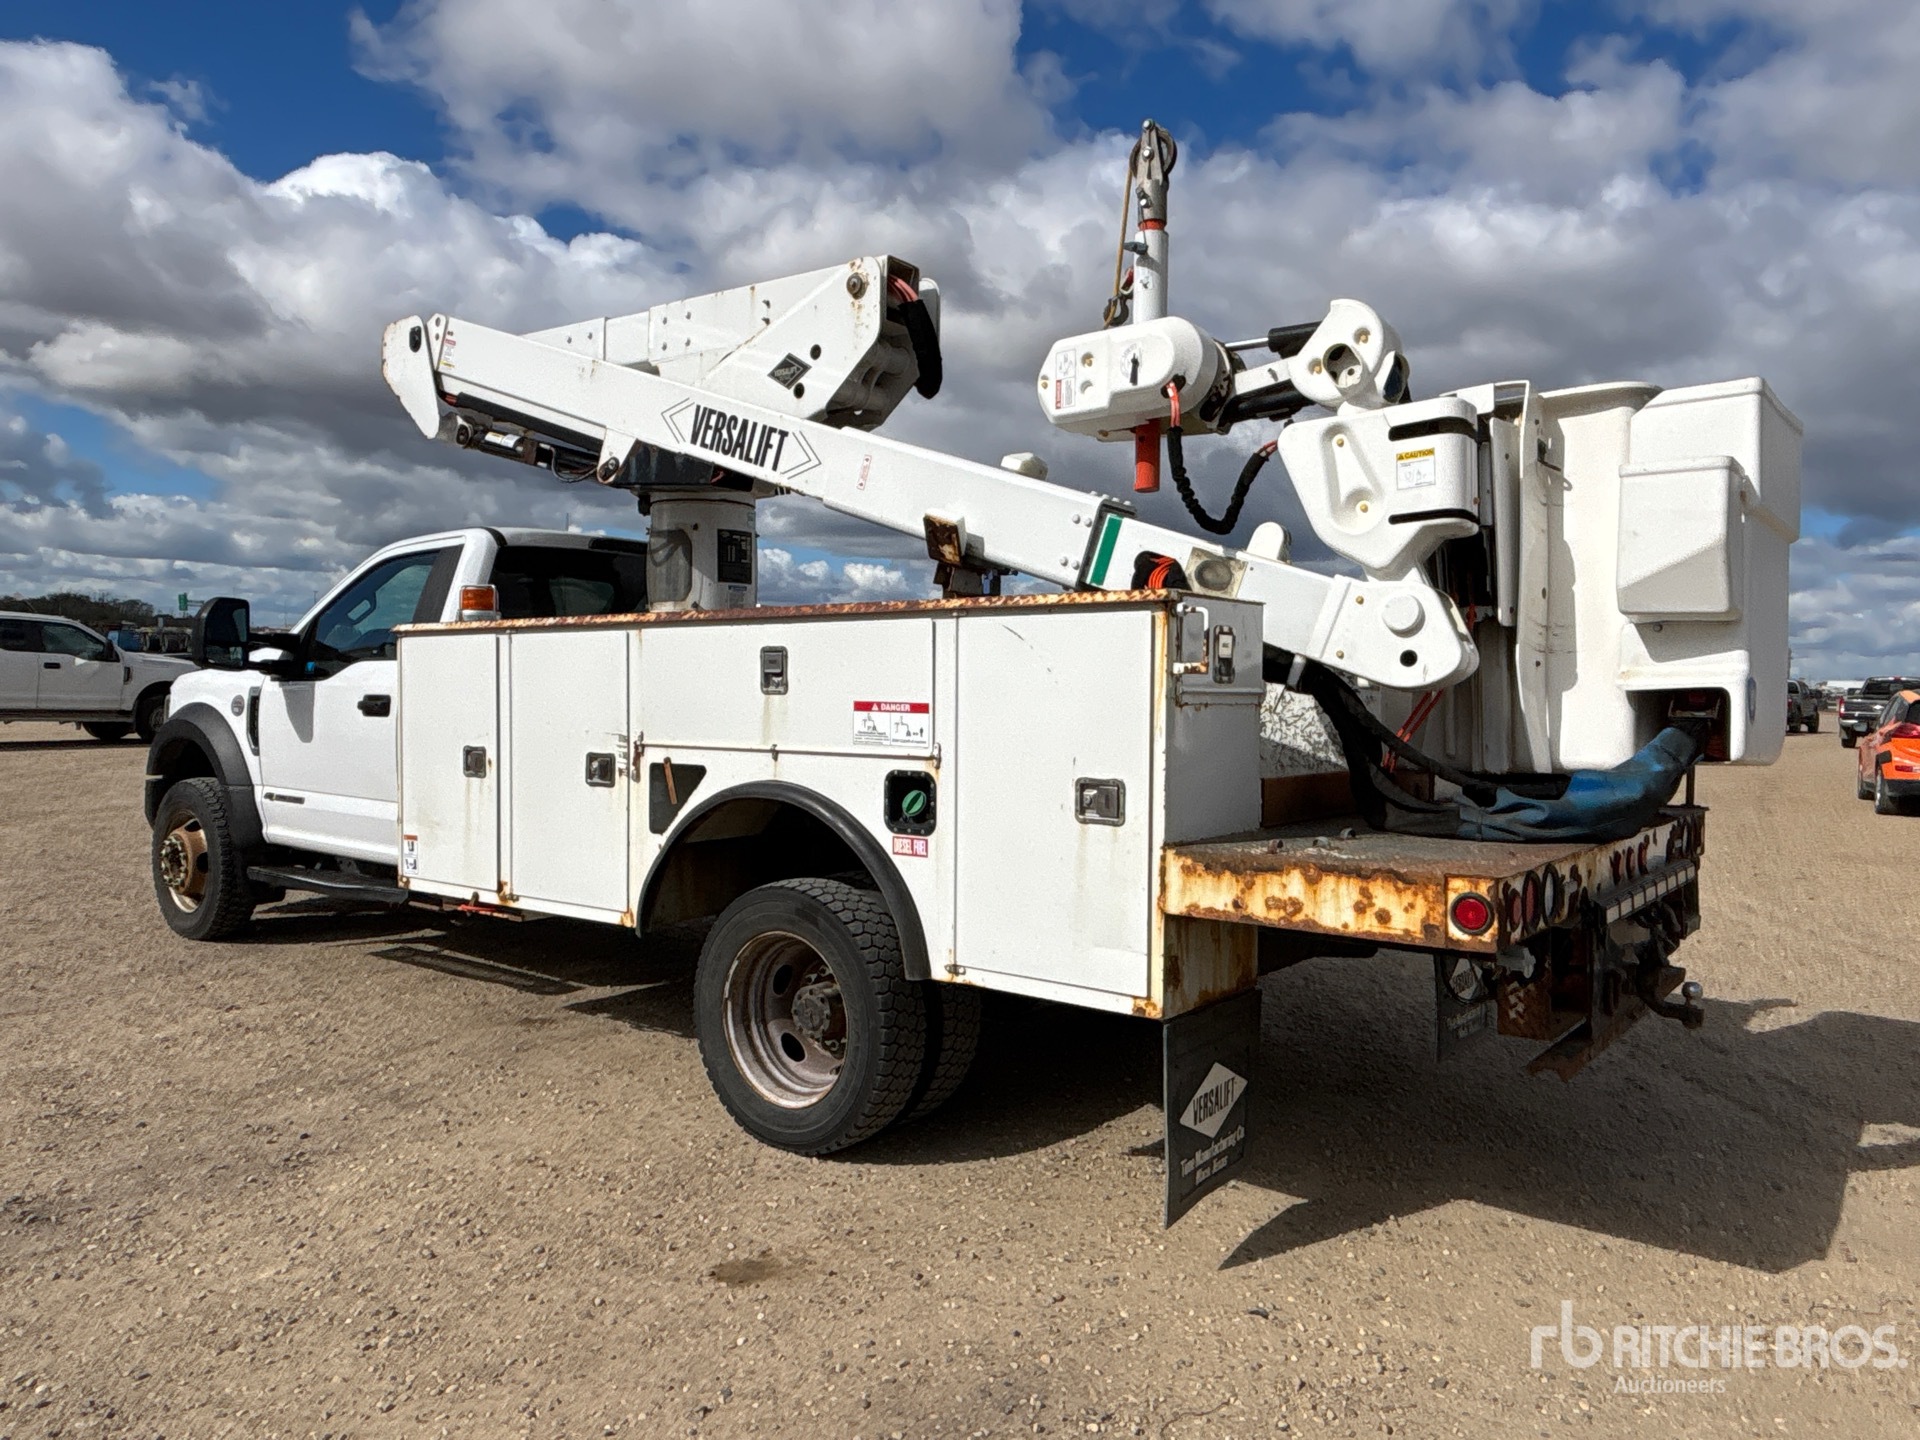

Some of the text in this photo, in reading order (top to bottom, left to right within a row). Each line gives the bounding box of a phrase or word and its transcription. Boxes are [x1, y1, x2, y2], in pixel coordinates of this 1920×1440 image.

[690, 404, 789, 472] VERSALIFT
[1404, 448, 1434, 459] CAUTION
[880, 703, 911, 712] DANGER
[1193, 1076, 1236, 1126] VERSALIFT
